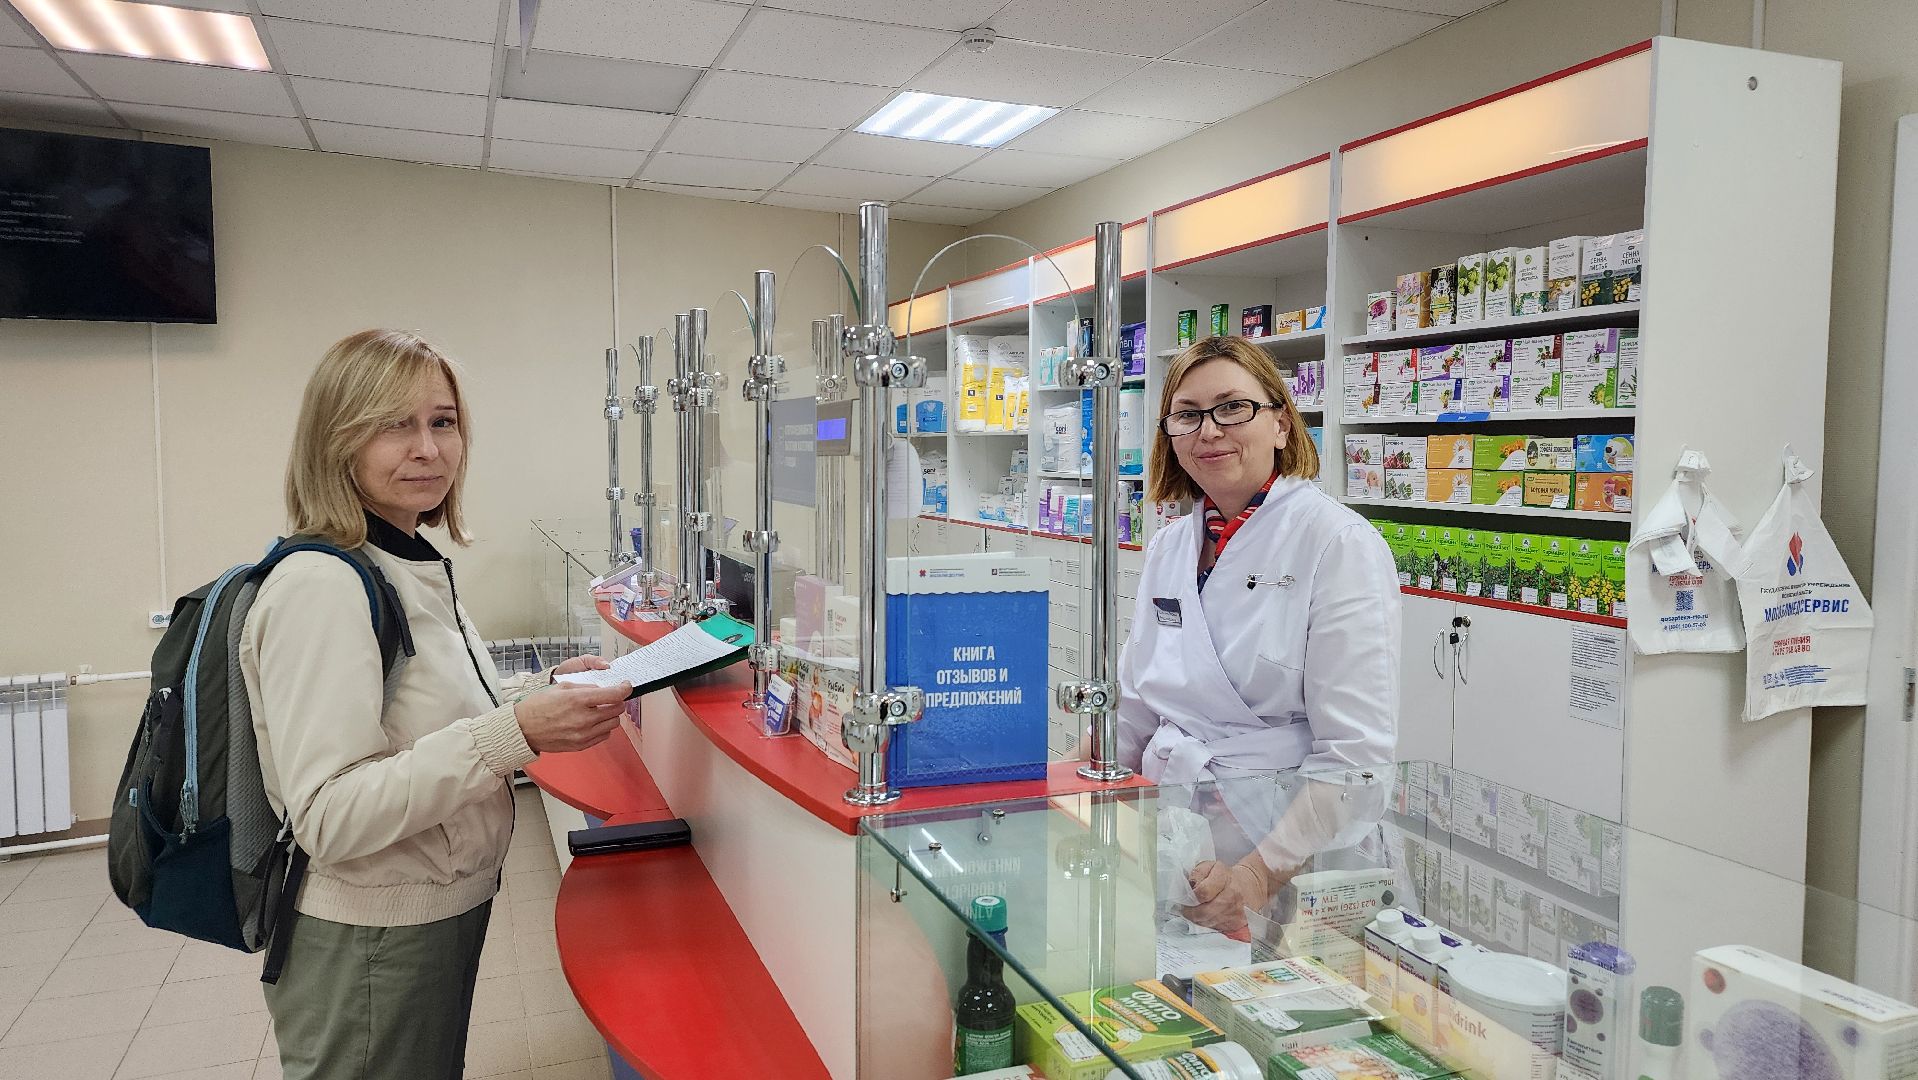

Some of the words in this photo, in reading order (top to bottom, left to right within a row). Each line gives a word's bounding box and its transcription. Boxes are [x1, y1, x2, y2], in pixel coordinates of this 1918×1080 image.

[953, 645, 996, 662] КНИГА
[936, 669, 997, 685] ОТЗЫВОВ
[999, 669, 1008, 683] И
[926, 686, 1022, 708] ПРЕДЛОЖЕНИЙ
[1131, 990, 1182, 1021] ФИТО
